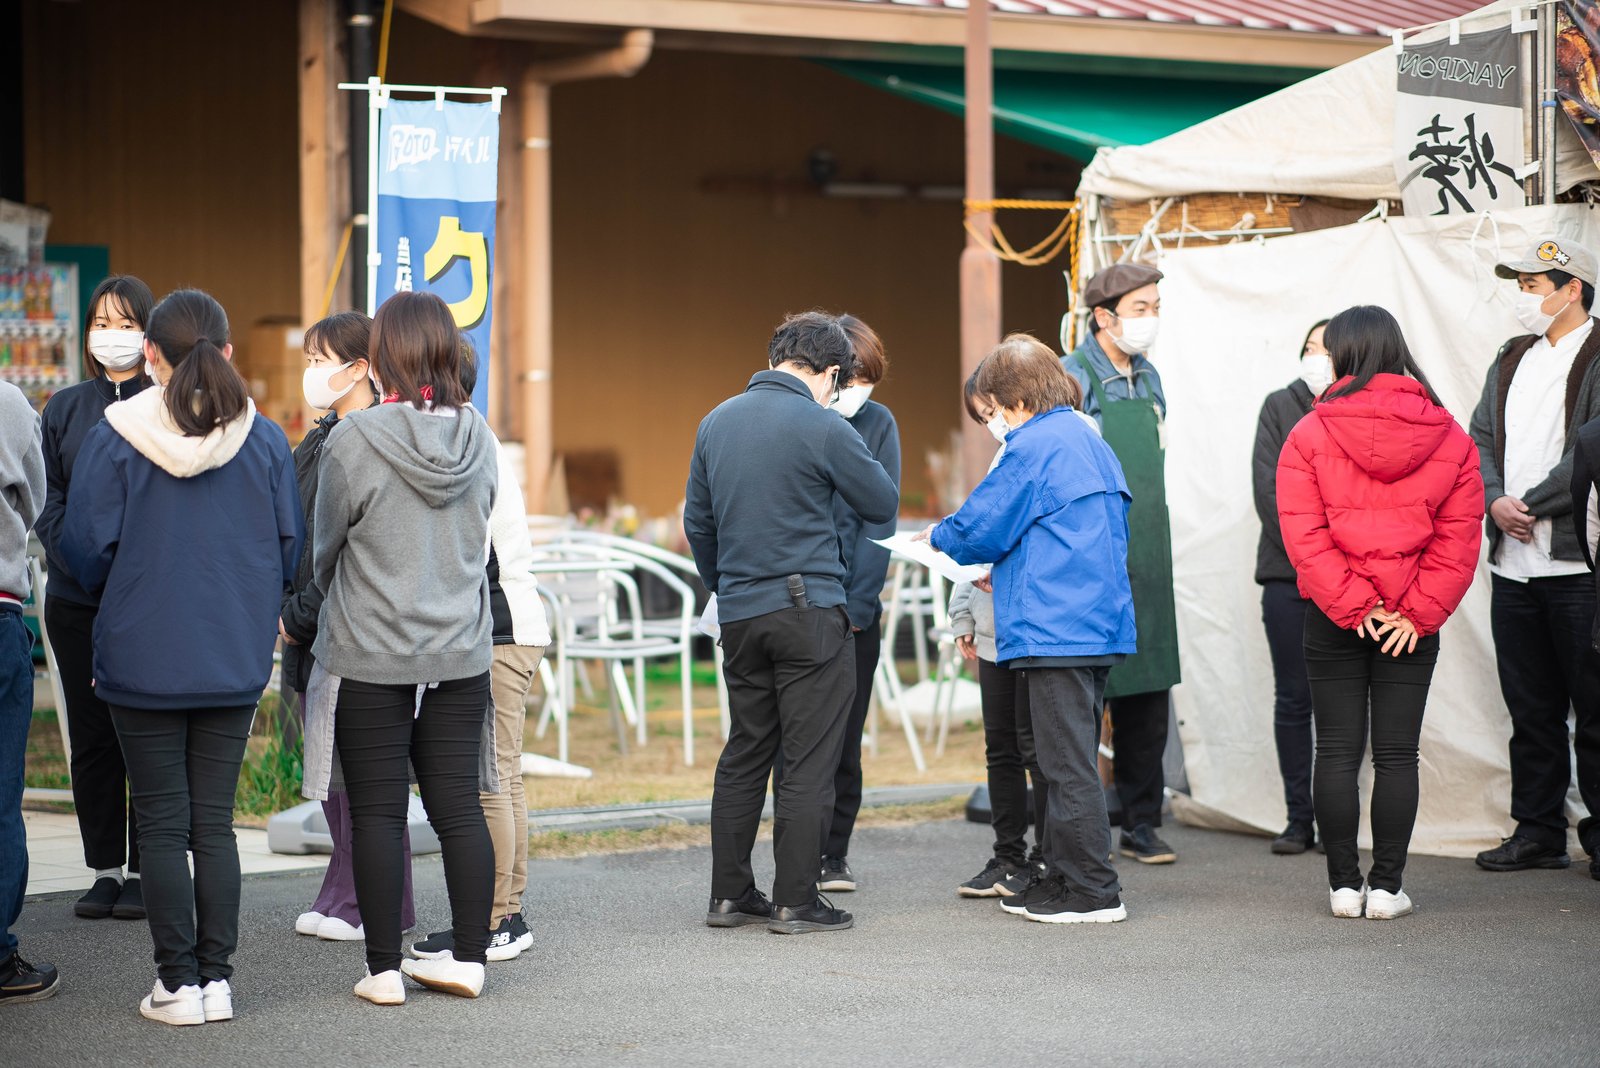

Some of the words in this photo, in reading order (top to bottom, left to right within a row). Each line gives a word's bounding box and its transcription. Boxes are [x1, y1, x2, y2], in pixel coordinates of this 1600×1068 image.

[444, 135, 490, 164] トラベル
[424, 216, 488, 328] ク
